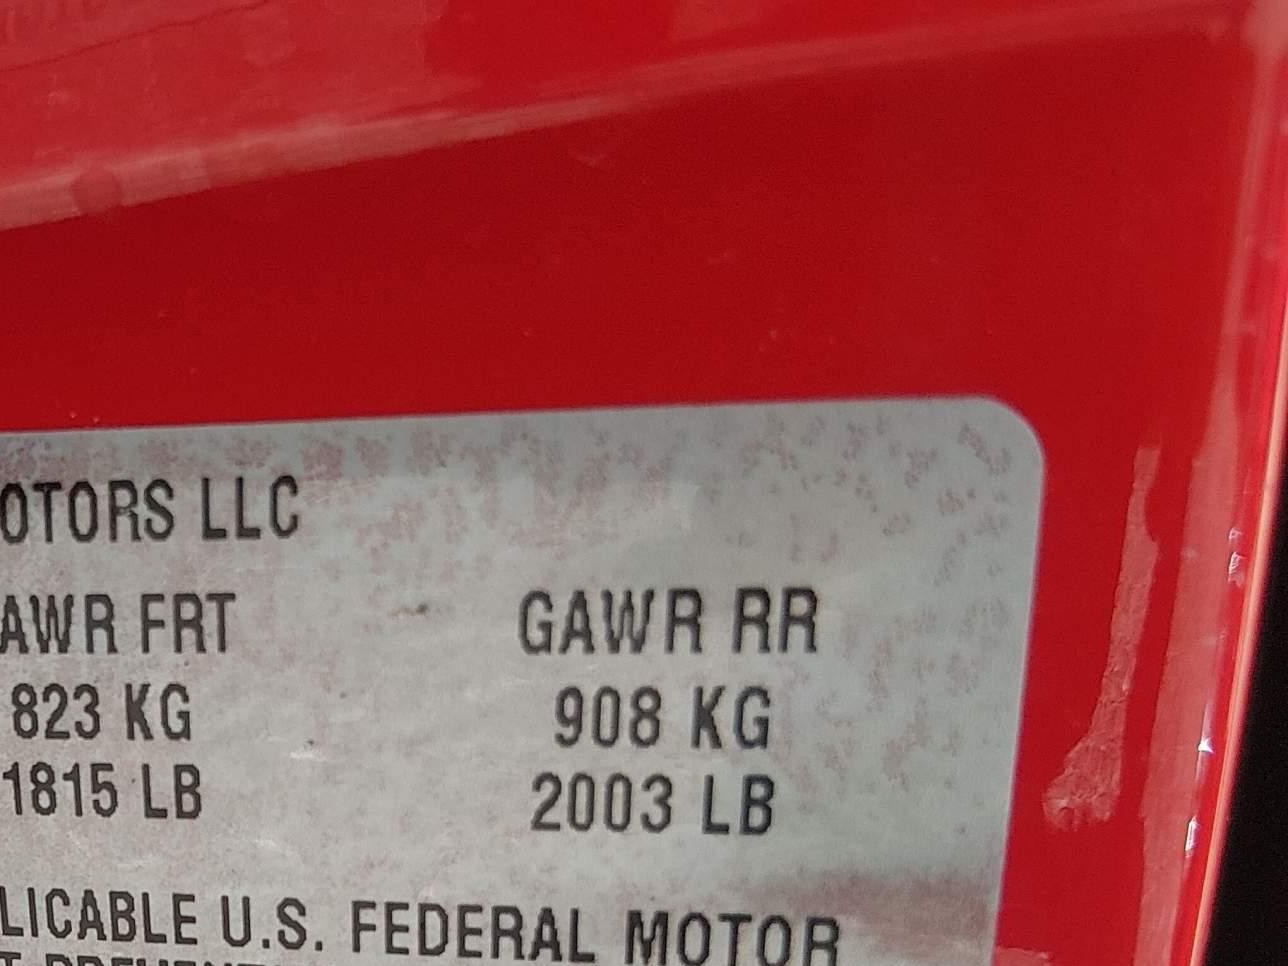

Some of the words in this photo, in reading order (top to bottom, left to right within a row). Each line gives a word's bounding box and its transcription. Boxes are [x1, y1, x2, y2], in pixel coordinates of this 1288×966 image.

[201, 475, 299, 540] LLC
[140, 593, 236, 654] FRT
[518, 589, 703, 654] GAWR
[731, 586, 819, 654] RR
[12, 682, 100, 740] 823
[125, 683, 192, 741] KG
[553, 685, 661, 749] 908
[690, 686, 772, 750] KG
[3, 762, 119, 819] 1815
[142, 764, 202, 820] LB
[530, 773, 674, 832] 2003
[700, 773, 776, 837] LB
[220, 895, 324, 953] U.S.
[350, 900, 597, 964] FEDERAL
